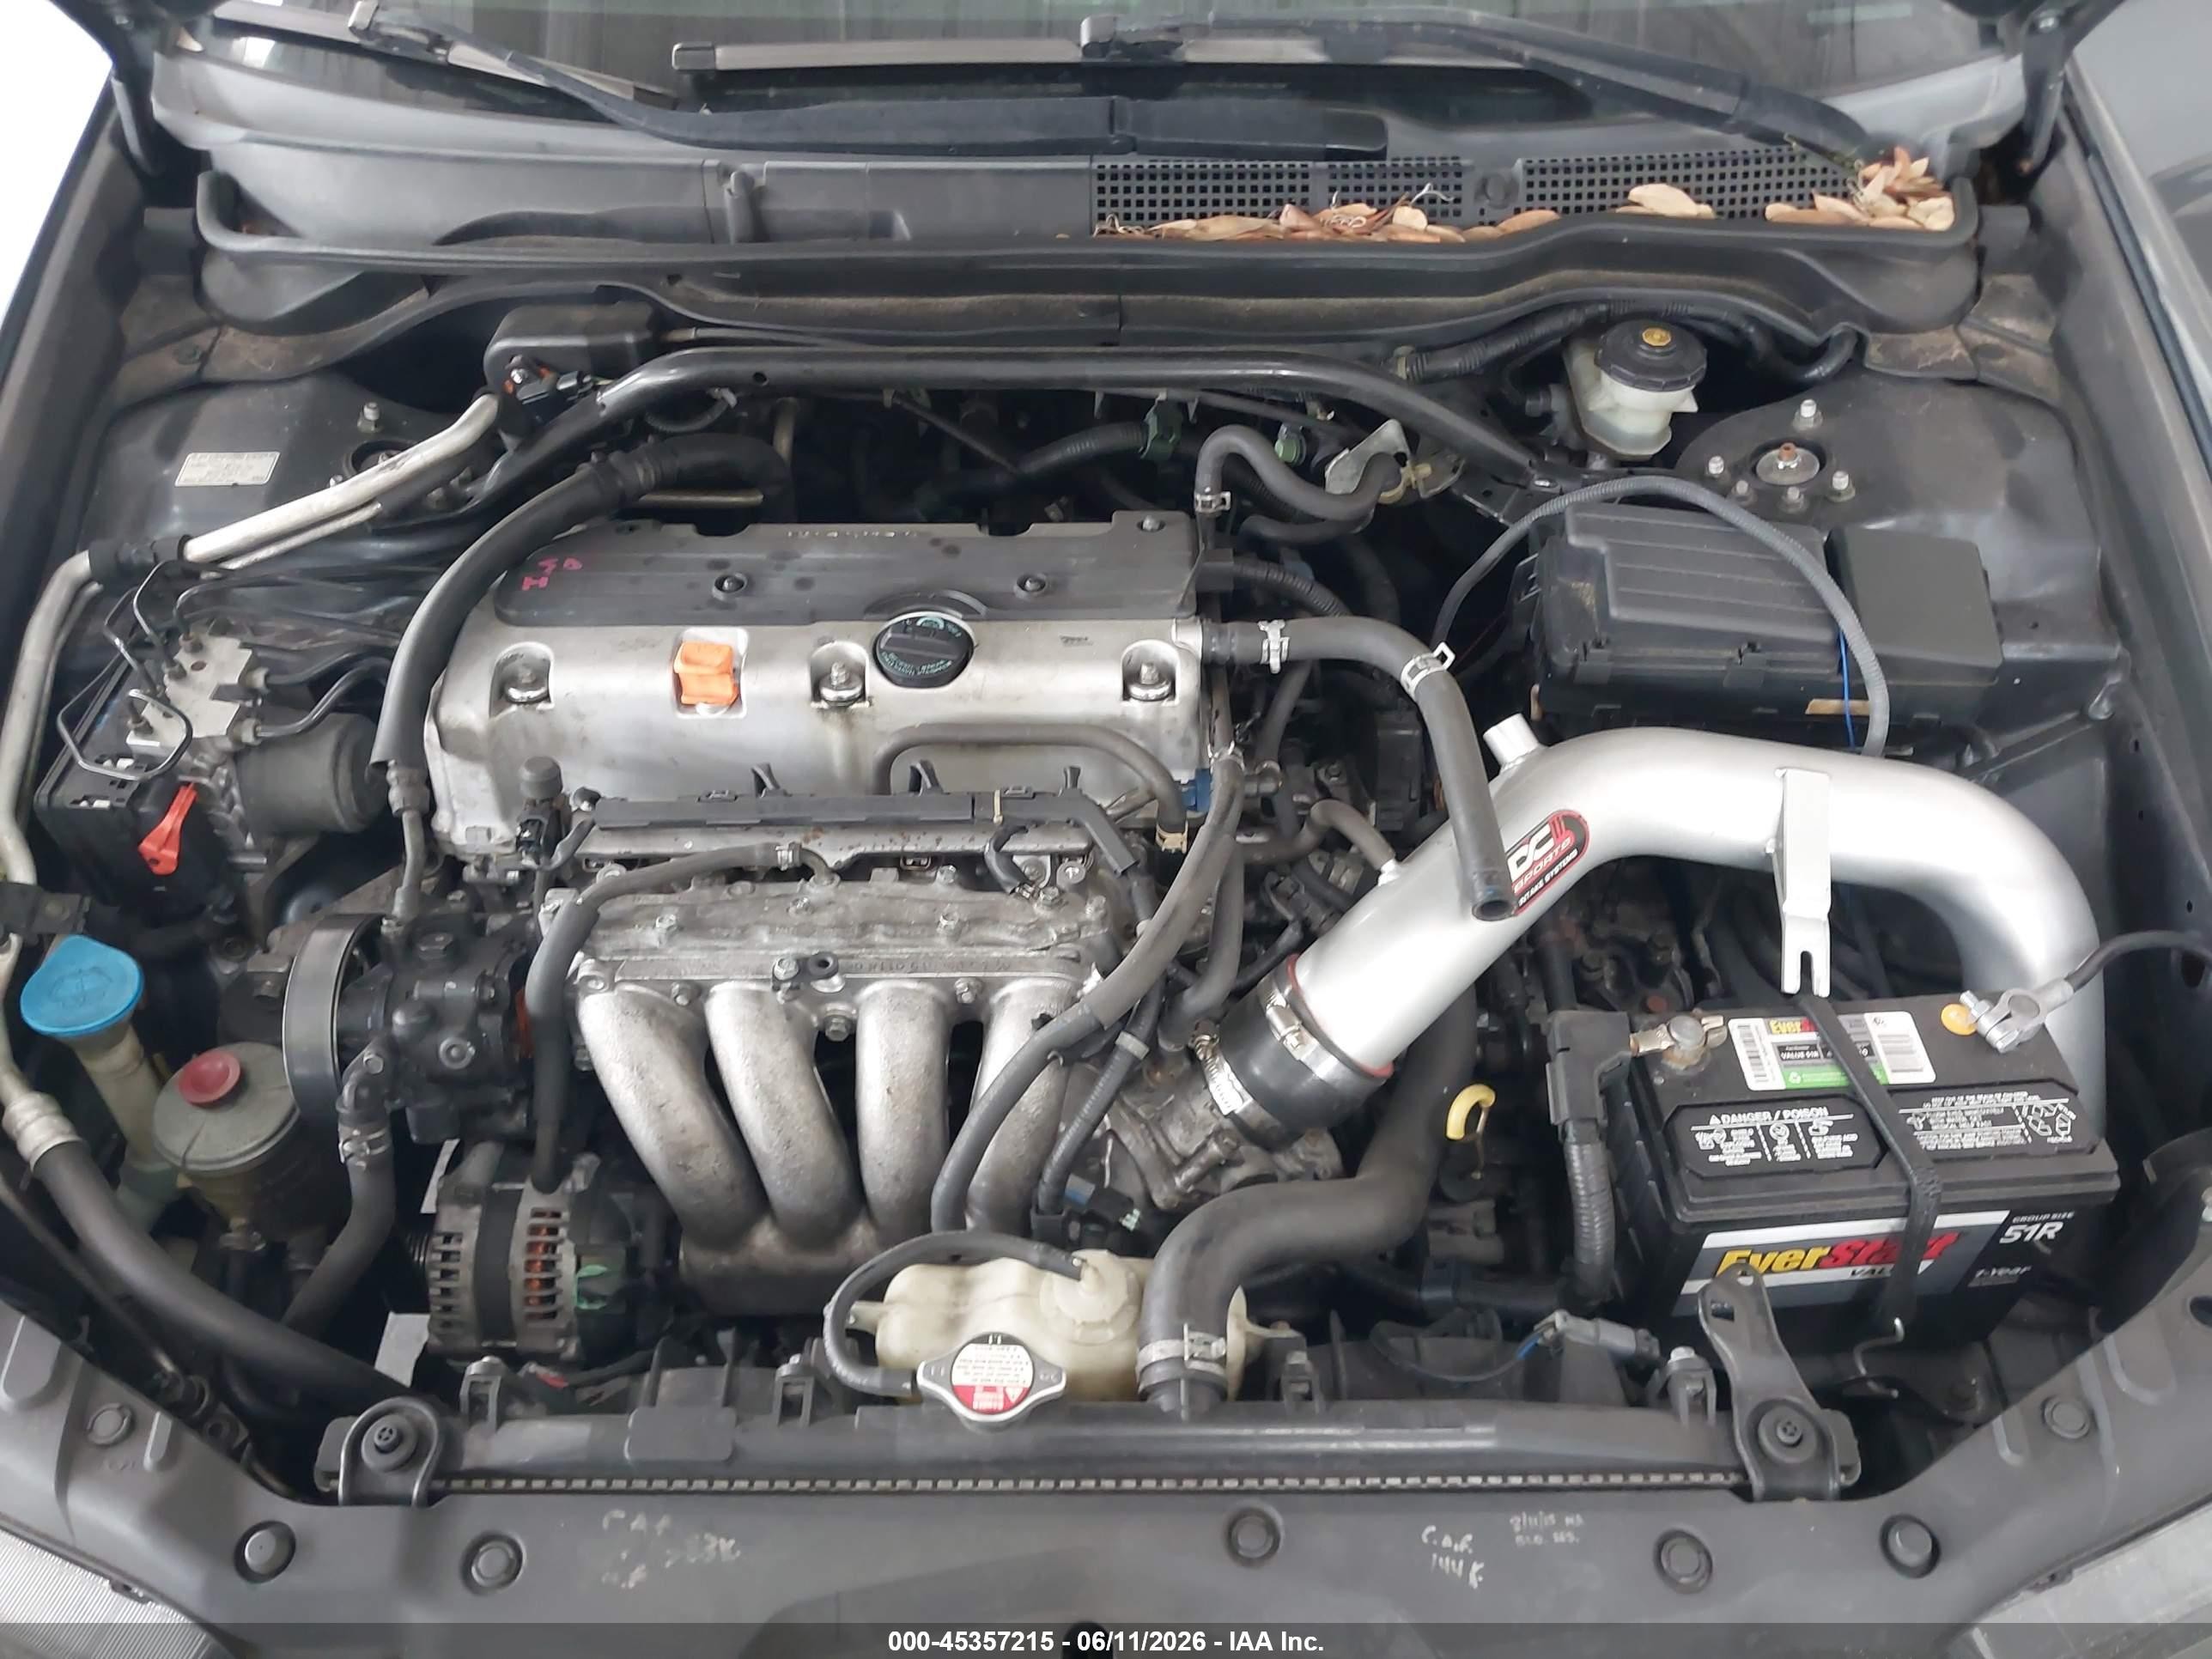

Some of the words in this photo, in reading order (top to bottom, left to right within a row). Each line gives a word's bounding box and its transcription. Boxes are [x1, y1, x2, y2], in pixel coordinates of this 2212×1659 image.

[1721, 1113, 1772, 1125] DANGER
[1782, 1106, 1829, 1120] POISON
[1999, 1220, 2063, 1244] 51R
